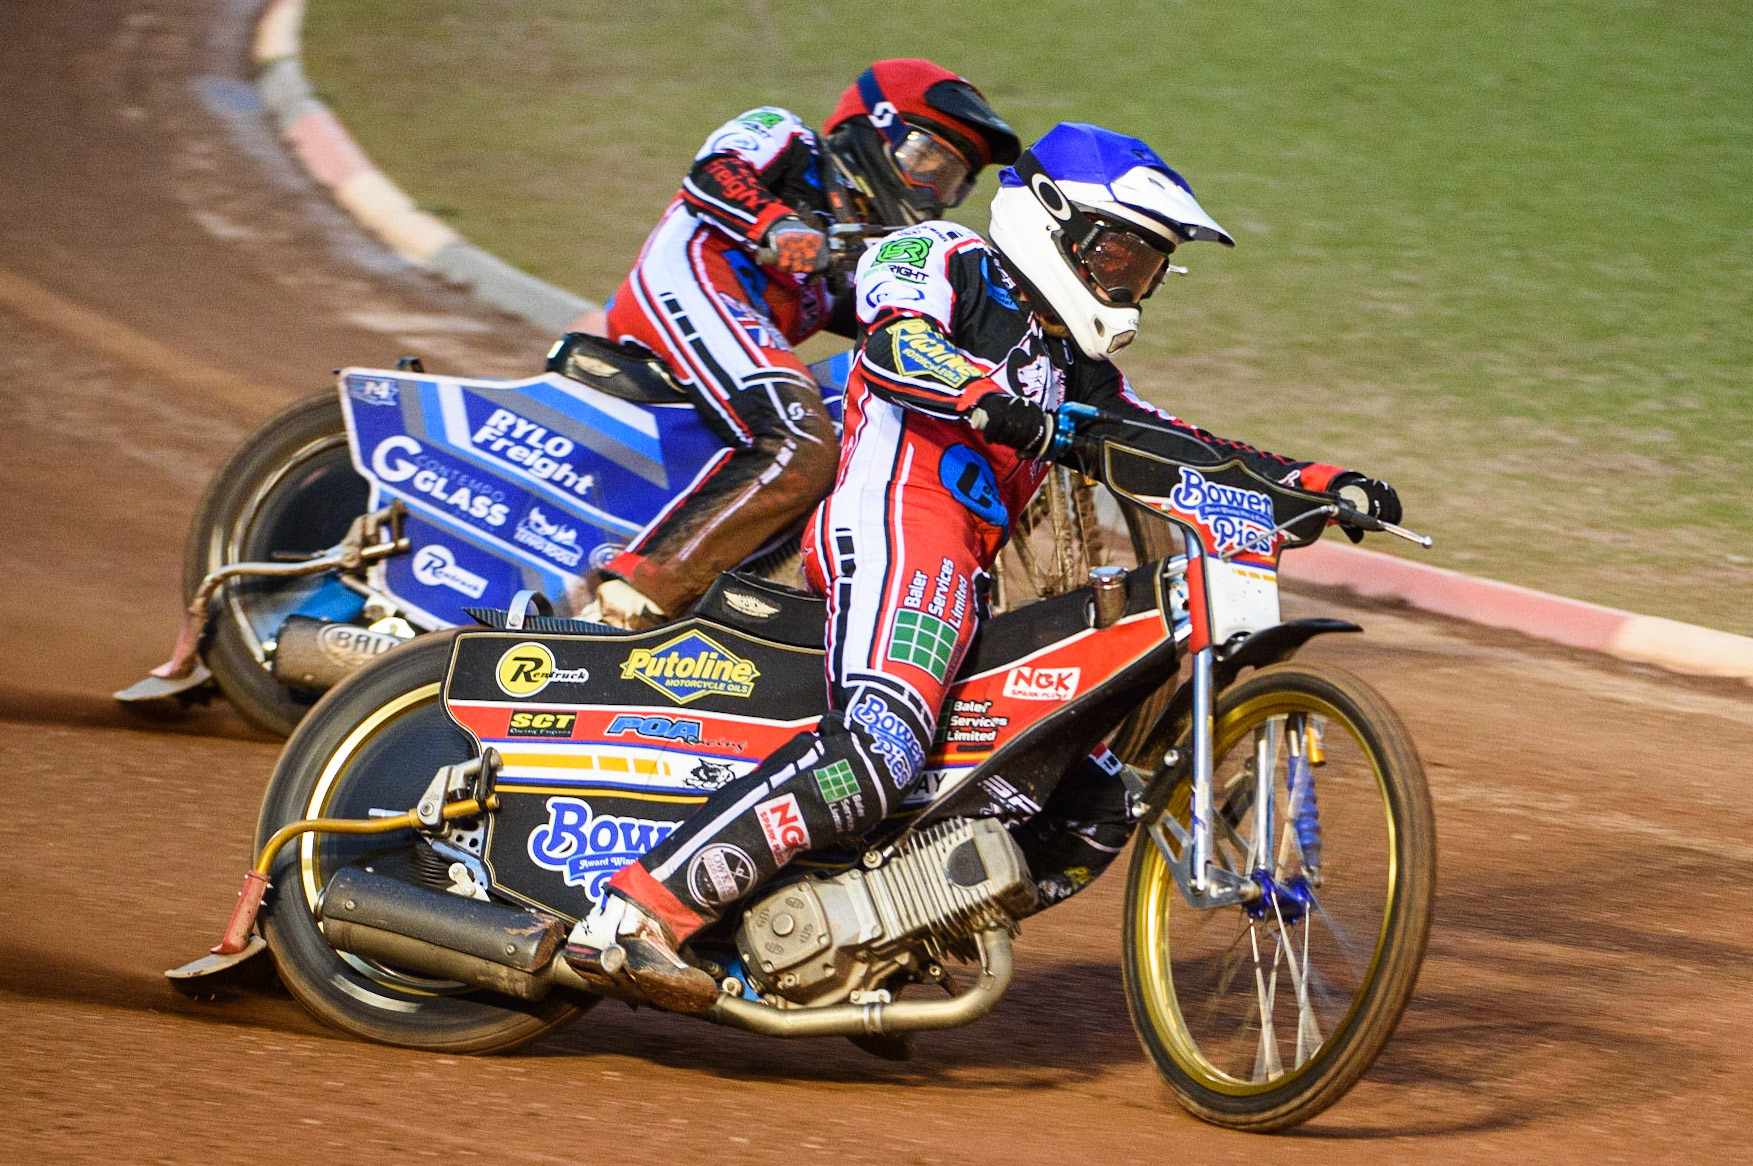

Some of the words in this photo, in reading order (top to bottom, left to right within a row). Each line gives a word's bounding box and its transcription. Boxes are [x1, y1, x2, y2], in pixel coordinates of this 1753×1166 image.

[485, 408, 575, 458] RYLO
[472, 425, 594, 495] Freight
[412, 470, 511, 527] GLASS
[1213, 516, 1271, 553] Pies
[903, 568, 929, 610] Baler
[926, 556, 955, 618] Services
[509, 656, 586, 683] Rentruck
[624, 650, 753, 683] Putoline
[1012, 667, 1074, 692] NGK
[664, 678, 726, 691] MOTORCYCLE
[726, 683, 749, 693] OILS
[510, 712, 577, 729] SCT
[949, 714, 1010, 728] Services
[952, 700, 993, 714] Baler
[605, 715, 700, 740] POA
[946, 729, 998, 742] Limited
[532, 802, 673, 867] Bow
[769, 801, 810, 851] NG
[578, 857, 610, 870] Award
